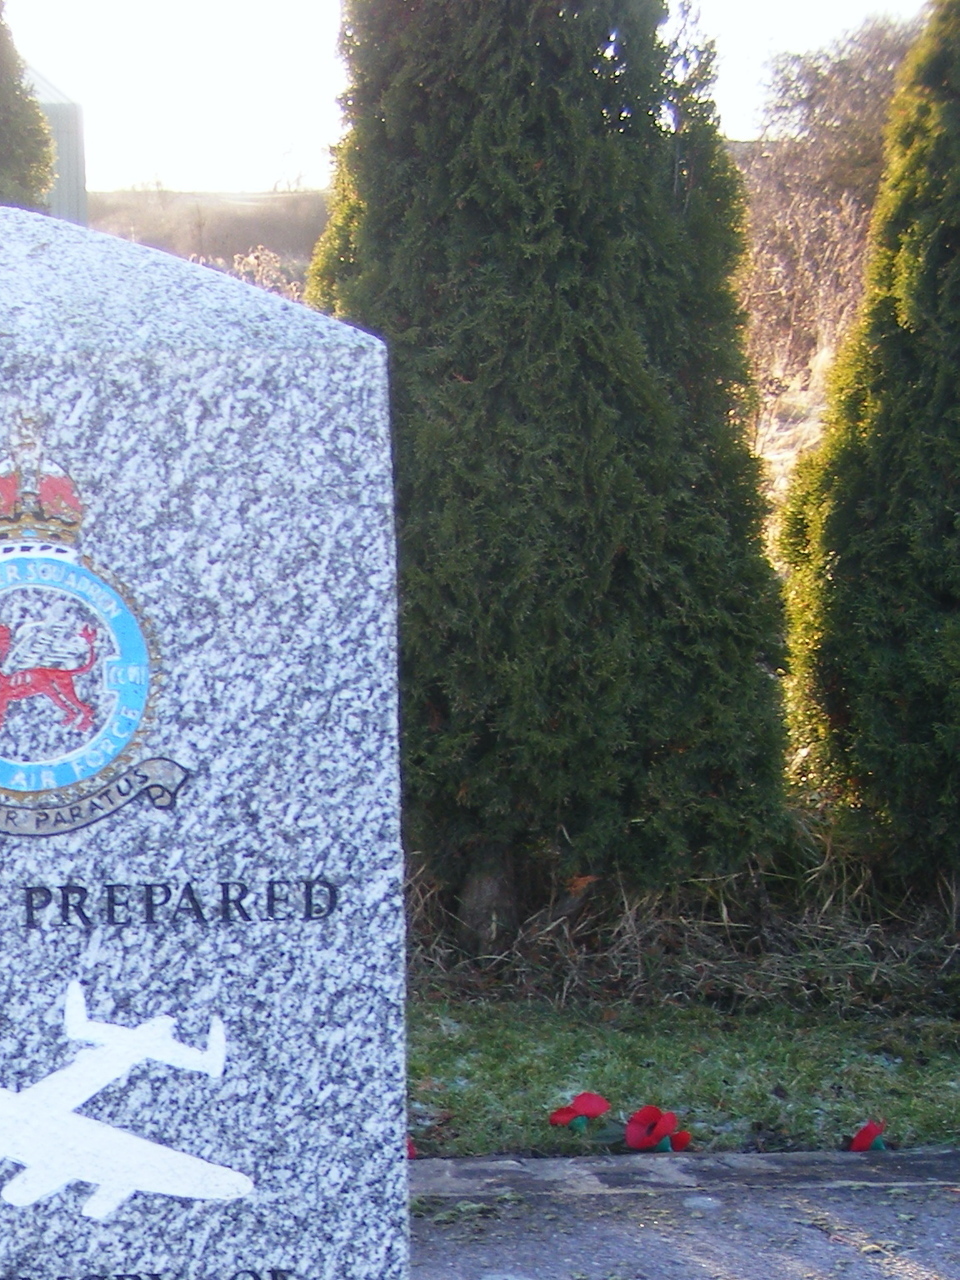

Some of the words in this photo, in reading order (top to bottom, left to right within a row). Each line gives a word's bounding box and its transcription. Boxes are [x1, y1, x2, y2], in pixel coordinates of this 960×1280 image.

[9, 770, 58, 789] AIR
[73, 705, 140, 780] FORCE
[34, 769, 149, 829] PARATUS
[22, 880, 339, 929] PREPARED
